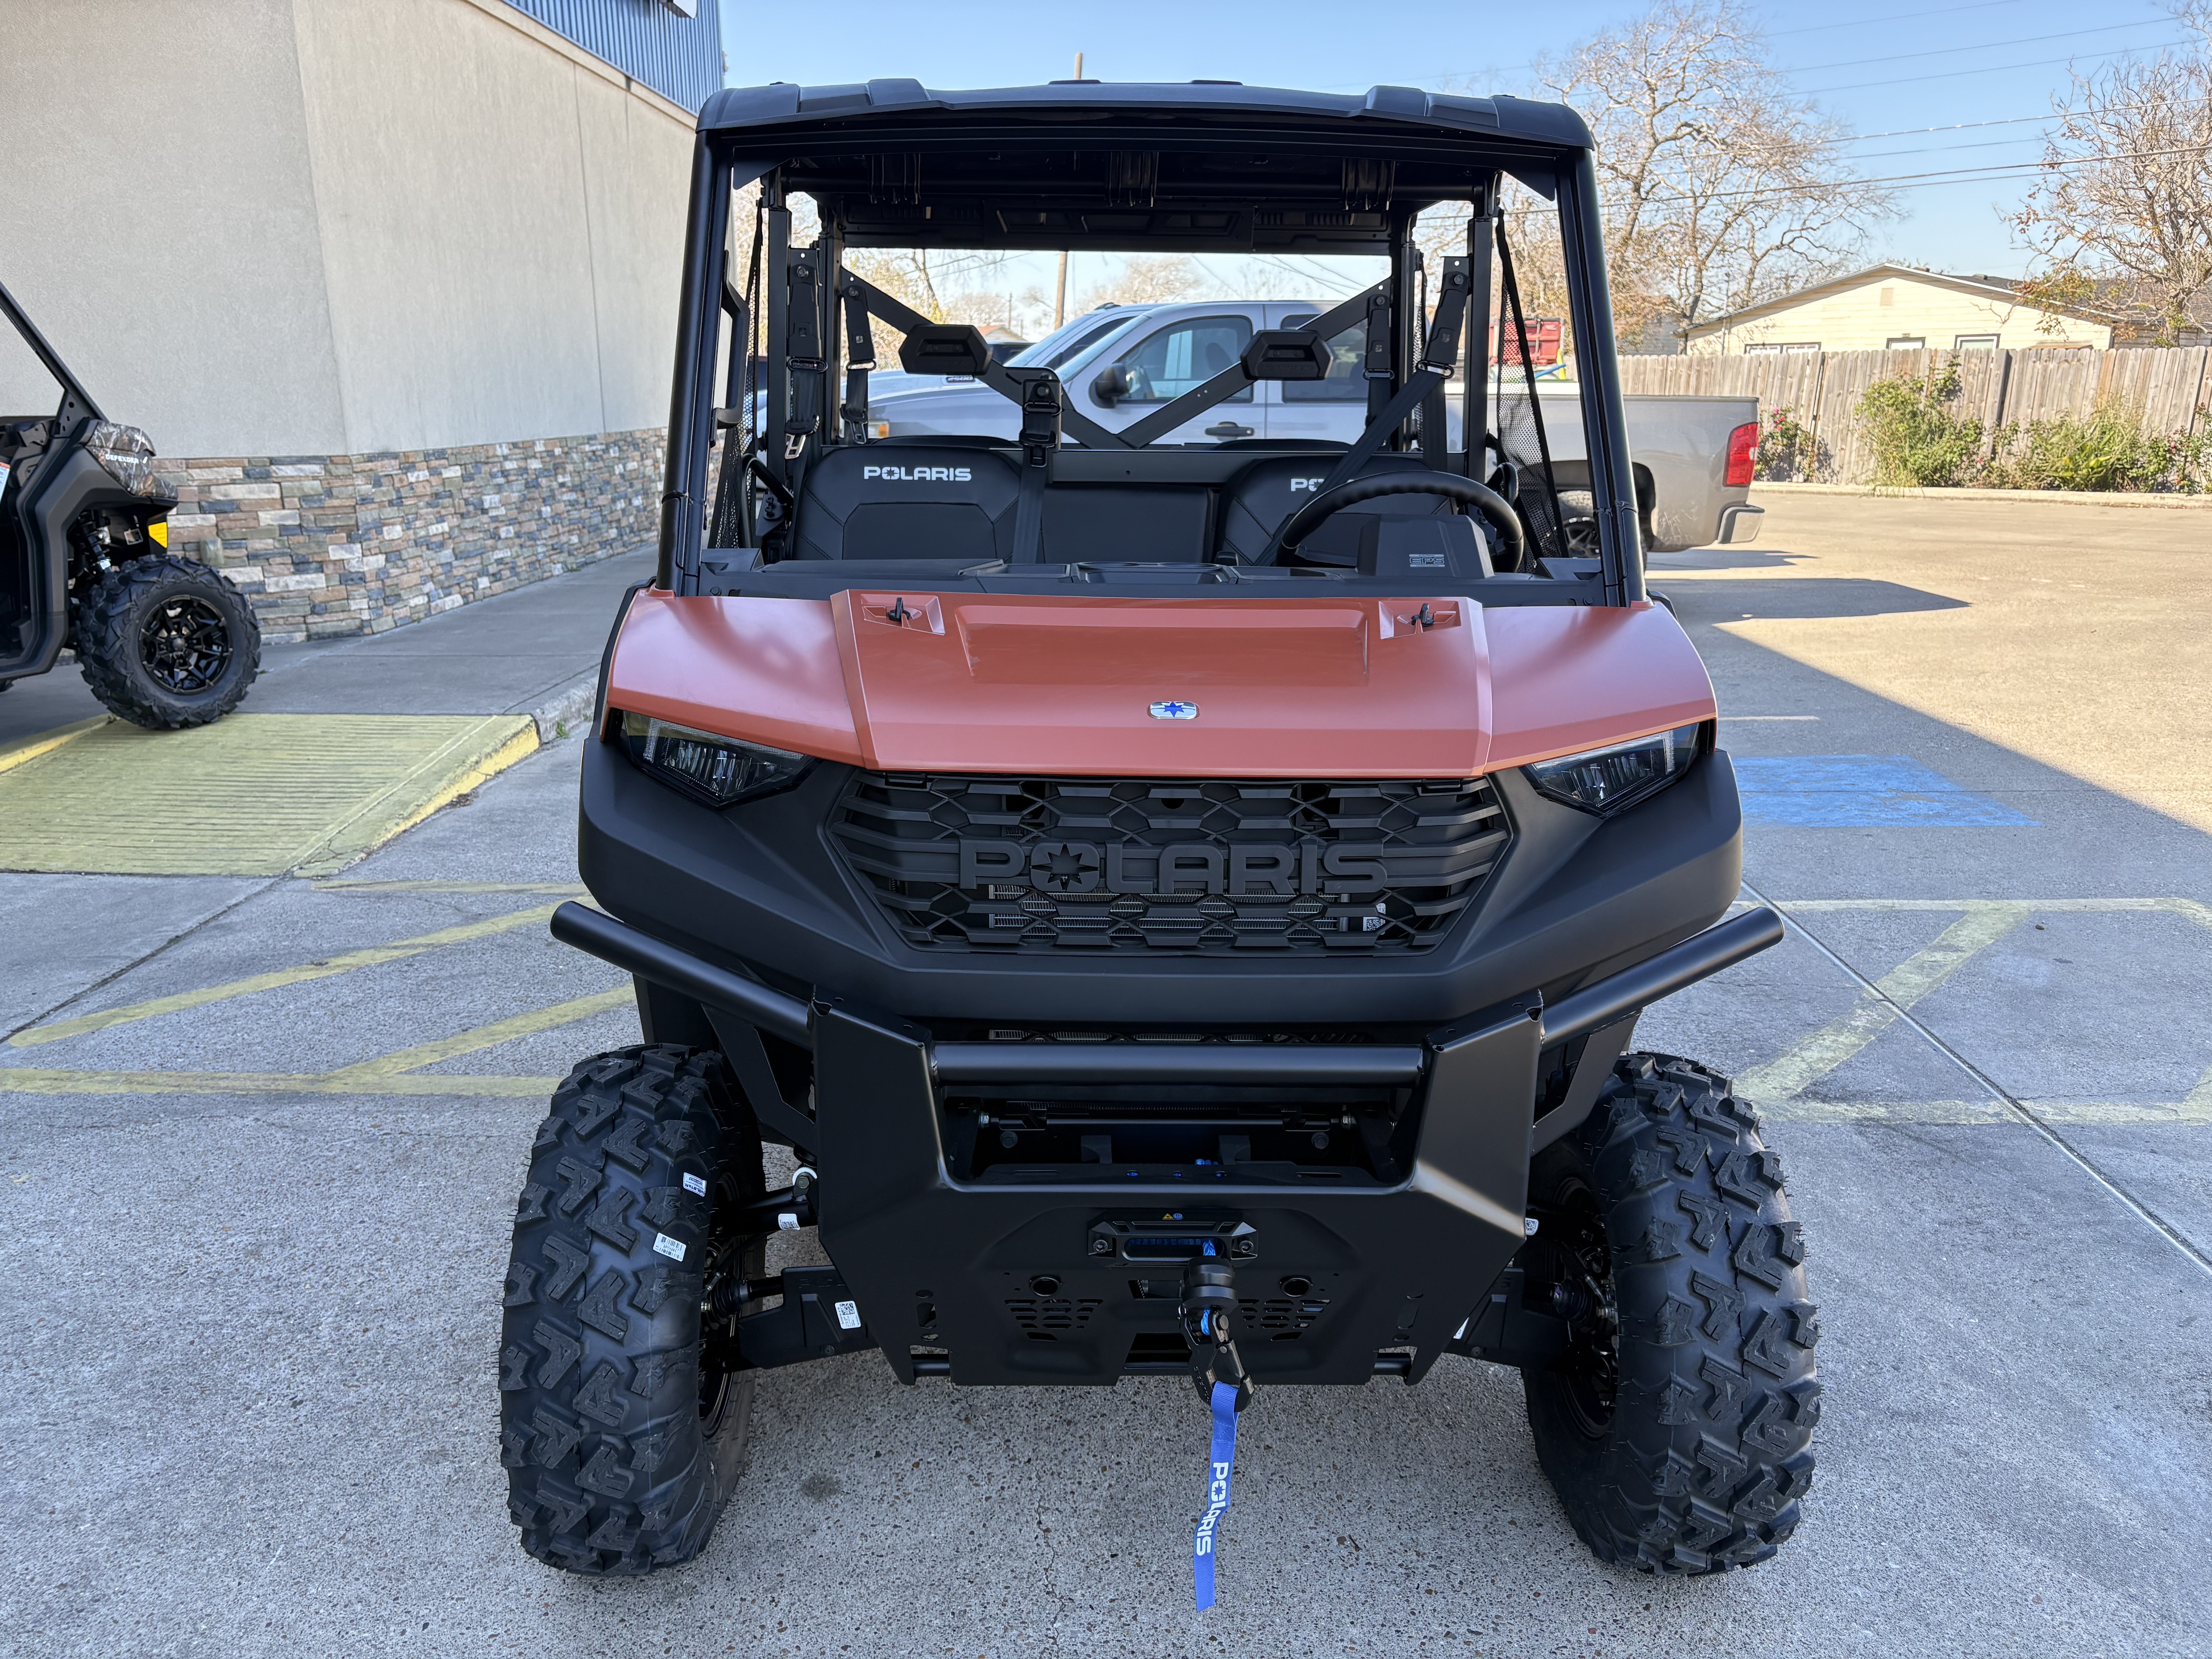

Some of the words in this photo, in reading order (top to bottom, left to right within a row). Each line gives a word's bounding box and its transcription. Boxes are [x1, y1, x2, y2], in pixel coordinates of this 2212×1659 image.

[105, 454, 139, 464] DEFENDER
[864, 466, 972, 481] POLARIS
[959, 839, 1388, 894] POLARIS
[1196, 1462, 1229, 1556] POLARIS
